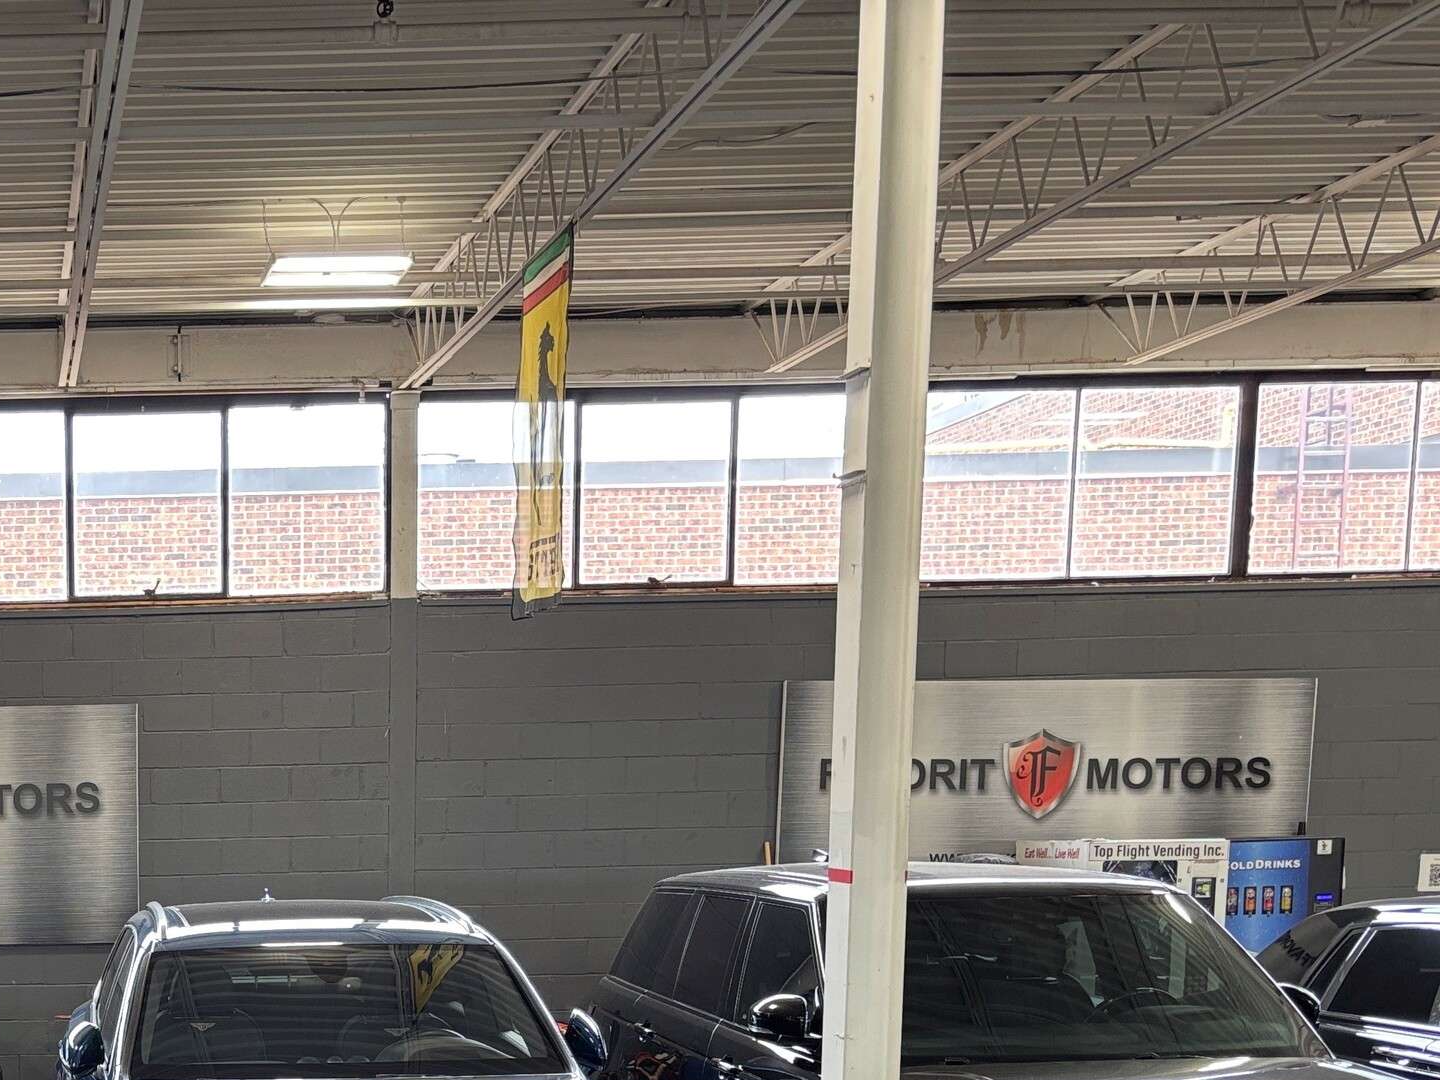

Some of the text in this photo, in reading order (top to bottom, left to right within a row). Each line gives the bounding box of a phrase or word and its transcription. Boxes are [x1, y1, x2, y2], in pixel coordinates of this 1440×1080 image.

[819, 758, 995, 791] FORIT
[1087, 756, 1272, 790] MOTORS
[1094, 844, 1225, 858] Top Flight Vending Inc.
[1227, 859, 1301, 870] OLD DRINKS
